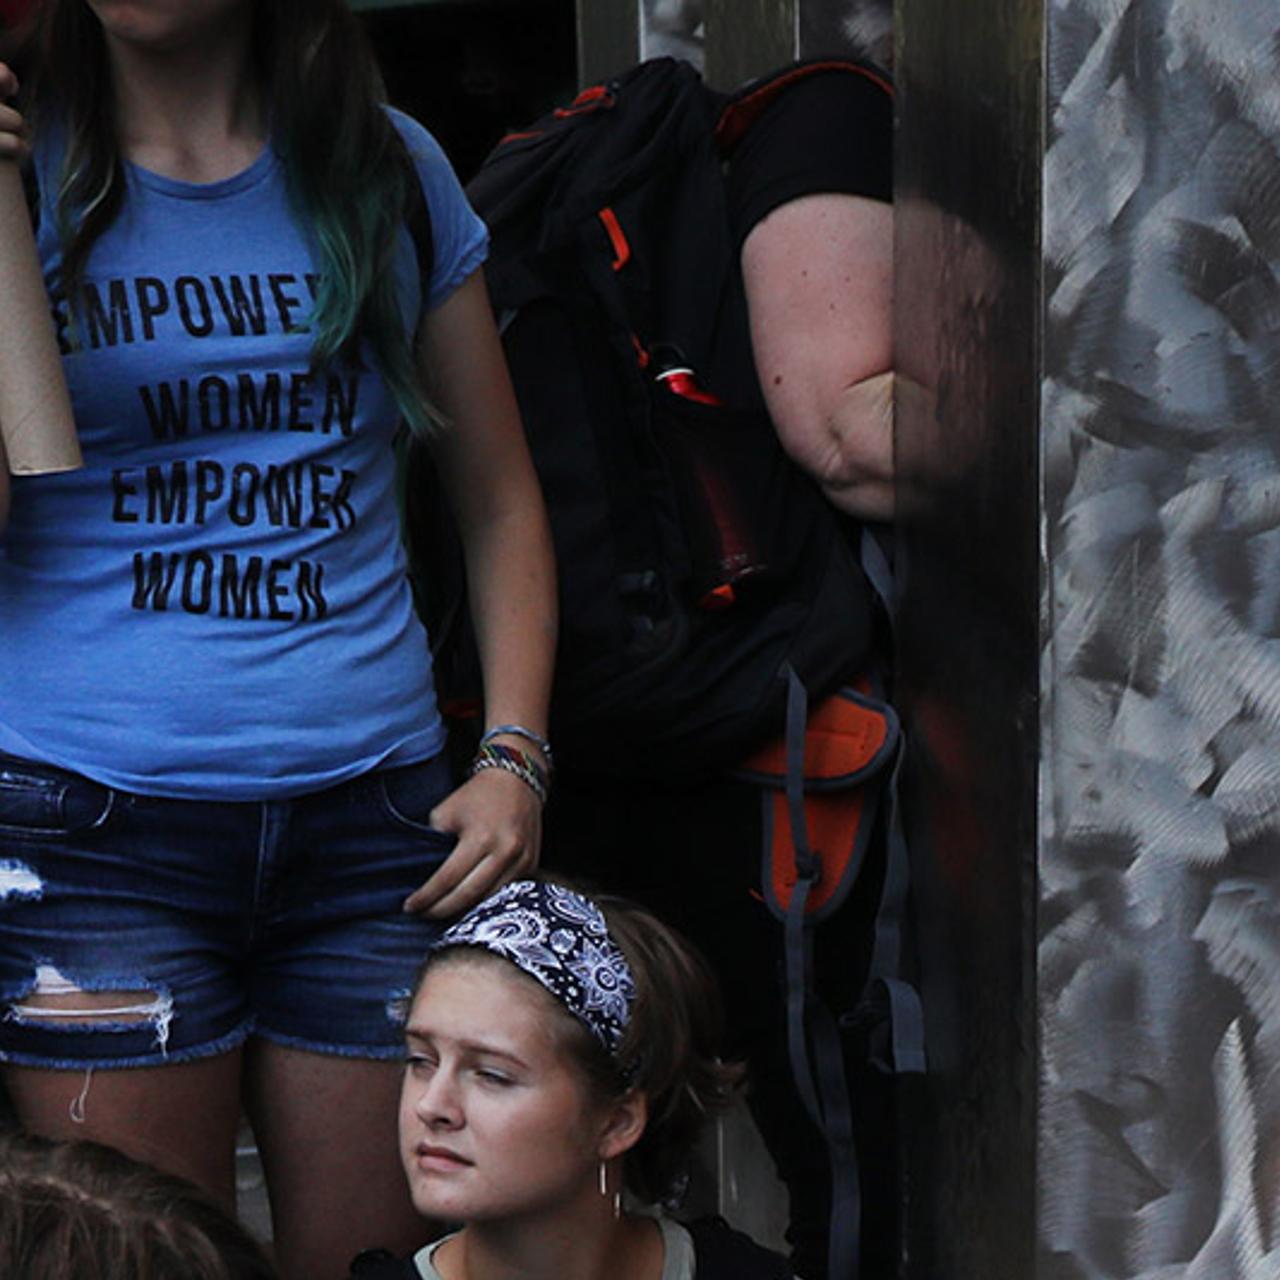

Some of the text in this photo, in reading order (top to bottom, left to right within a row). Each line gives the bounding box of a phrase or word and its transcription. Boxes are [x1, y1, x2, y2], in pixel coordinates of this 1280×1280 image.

[138, 372, 358, 440] WOMEN
[111, 459, 357, 531] EMPOWER
[131, 550, 328, 622] WOMEN
